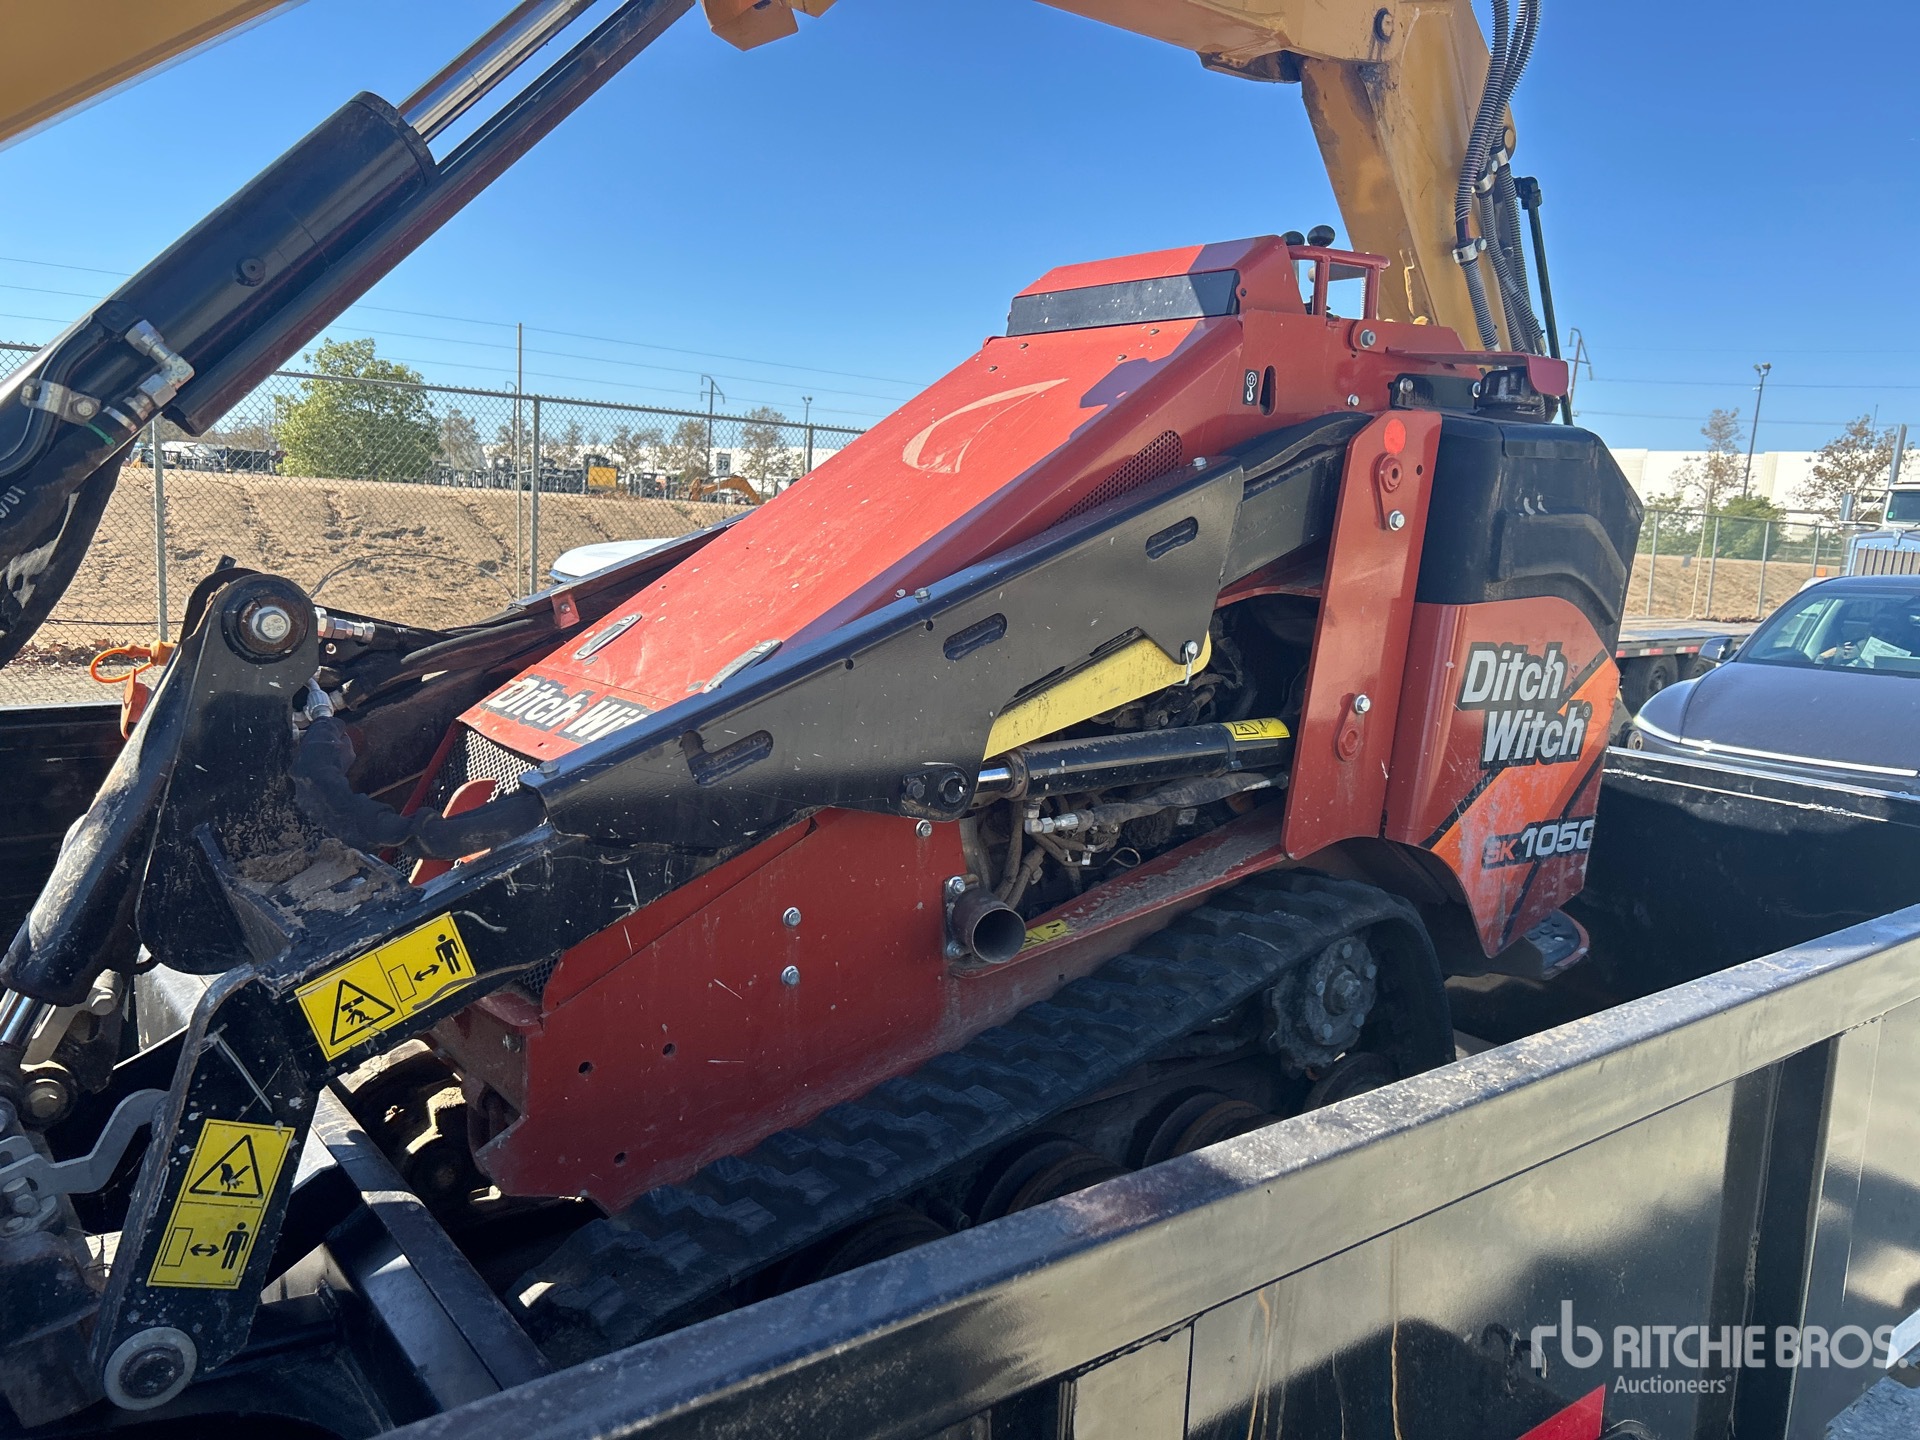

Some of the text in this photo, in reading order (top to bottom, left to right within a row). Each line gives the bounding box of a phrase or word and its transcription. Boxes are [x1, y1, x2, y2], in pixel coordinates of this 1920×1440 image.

[1461, 649, 1565, 703] Ditch
[485, 677, 586, 727] Ditch
[1484, 838, 1518, 864] SK
